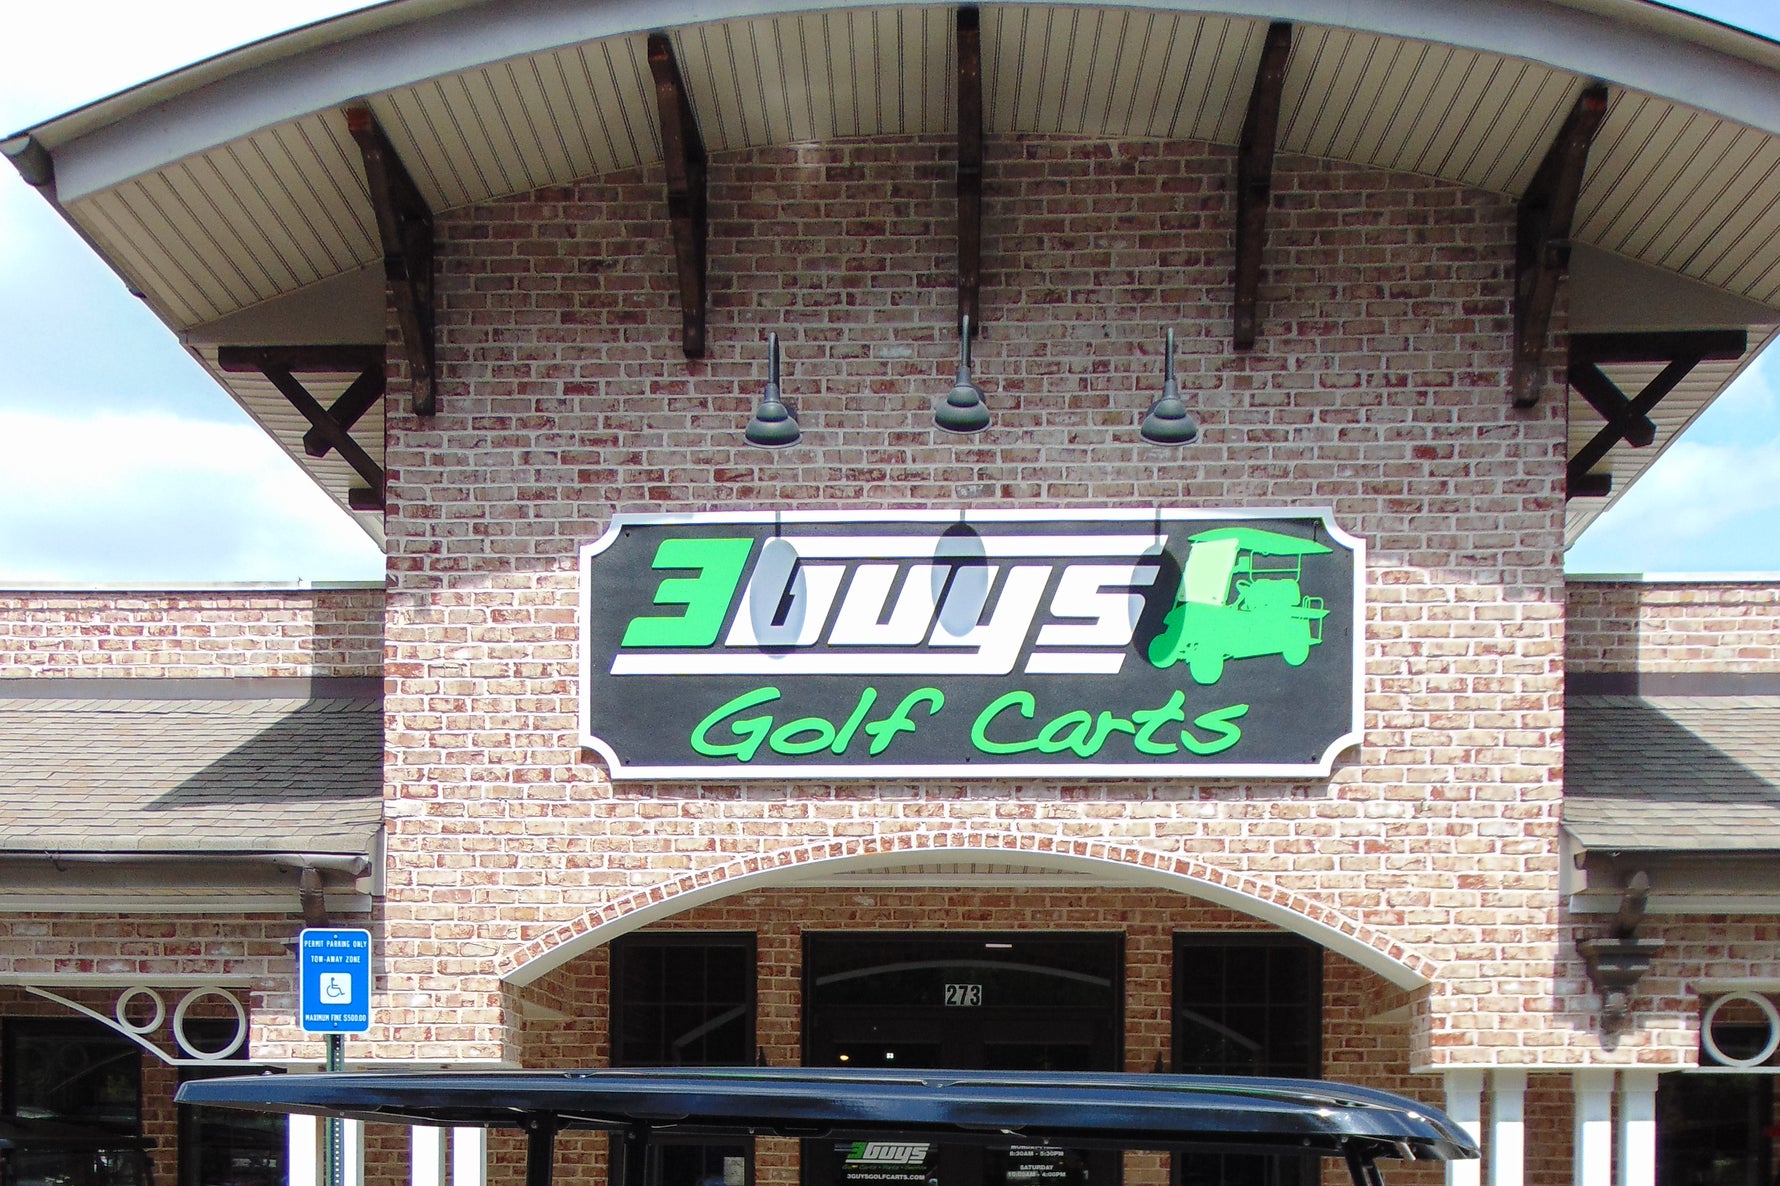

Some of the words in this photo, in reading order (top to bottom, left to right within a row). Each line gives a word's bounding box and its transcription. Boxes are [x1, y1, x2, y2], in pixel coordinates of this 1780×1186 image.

[690, 687, 943, 762] Golf
[971, 690, 1250, 758] Carts
[304, 940, 324, 948] PERMIT
[326, 940, 350, 948] PARKING
[353, 940, 368, 948] ONLY
[311, 955, 343, 963] TOW-AWAY
[345, 955, 361, 963] ZONE
[946, 985, 981, 1005] 273
[305, 1014, 329, 1022] MAXIMUM
[331, 1014, 342, 1022] FINE
